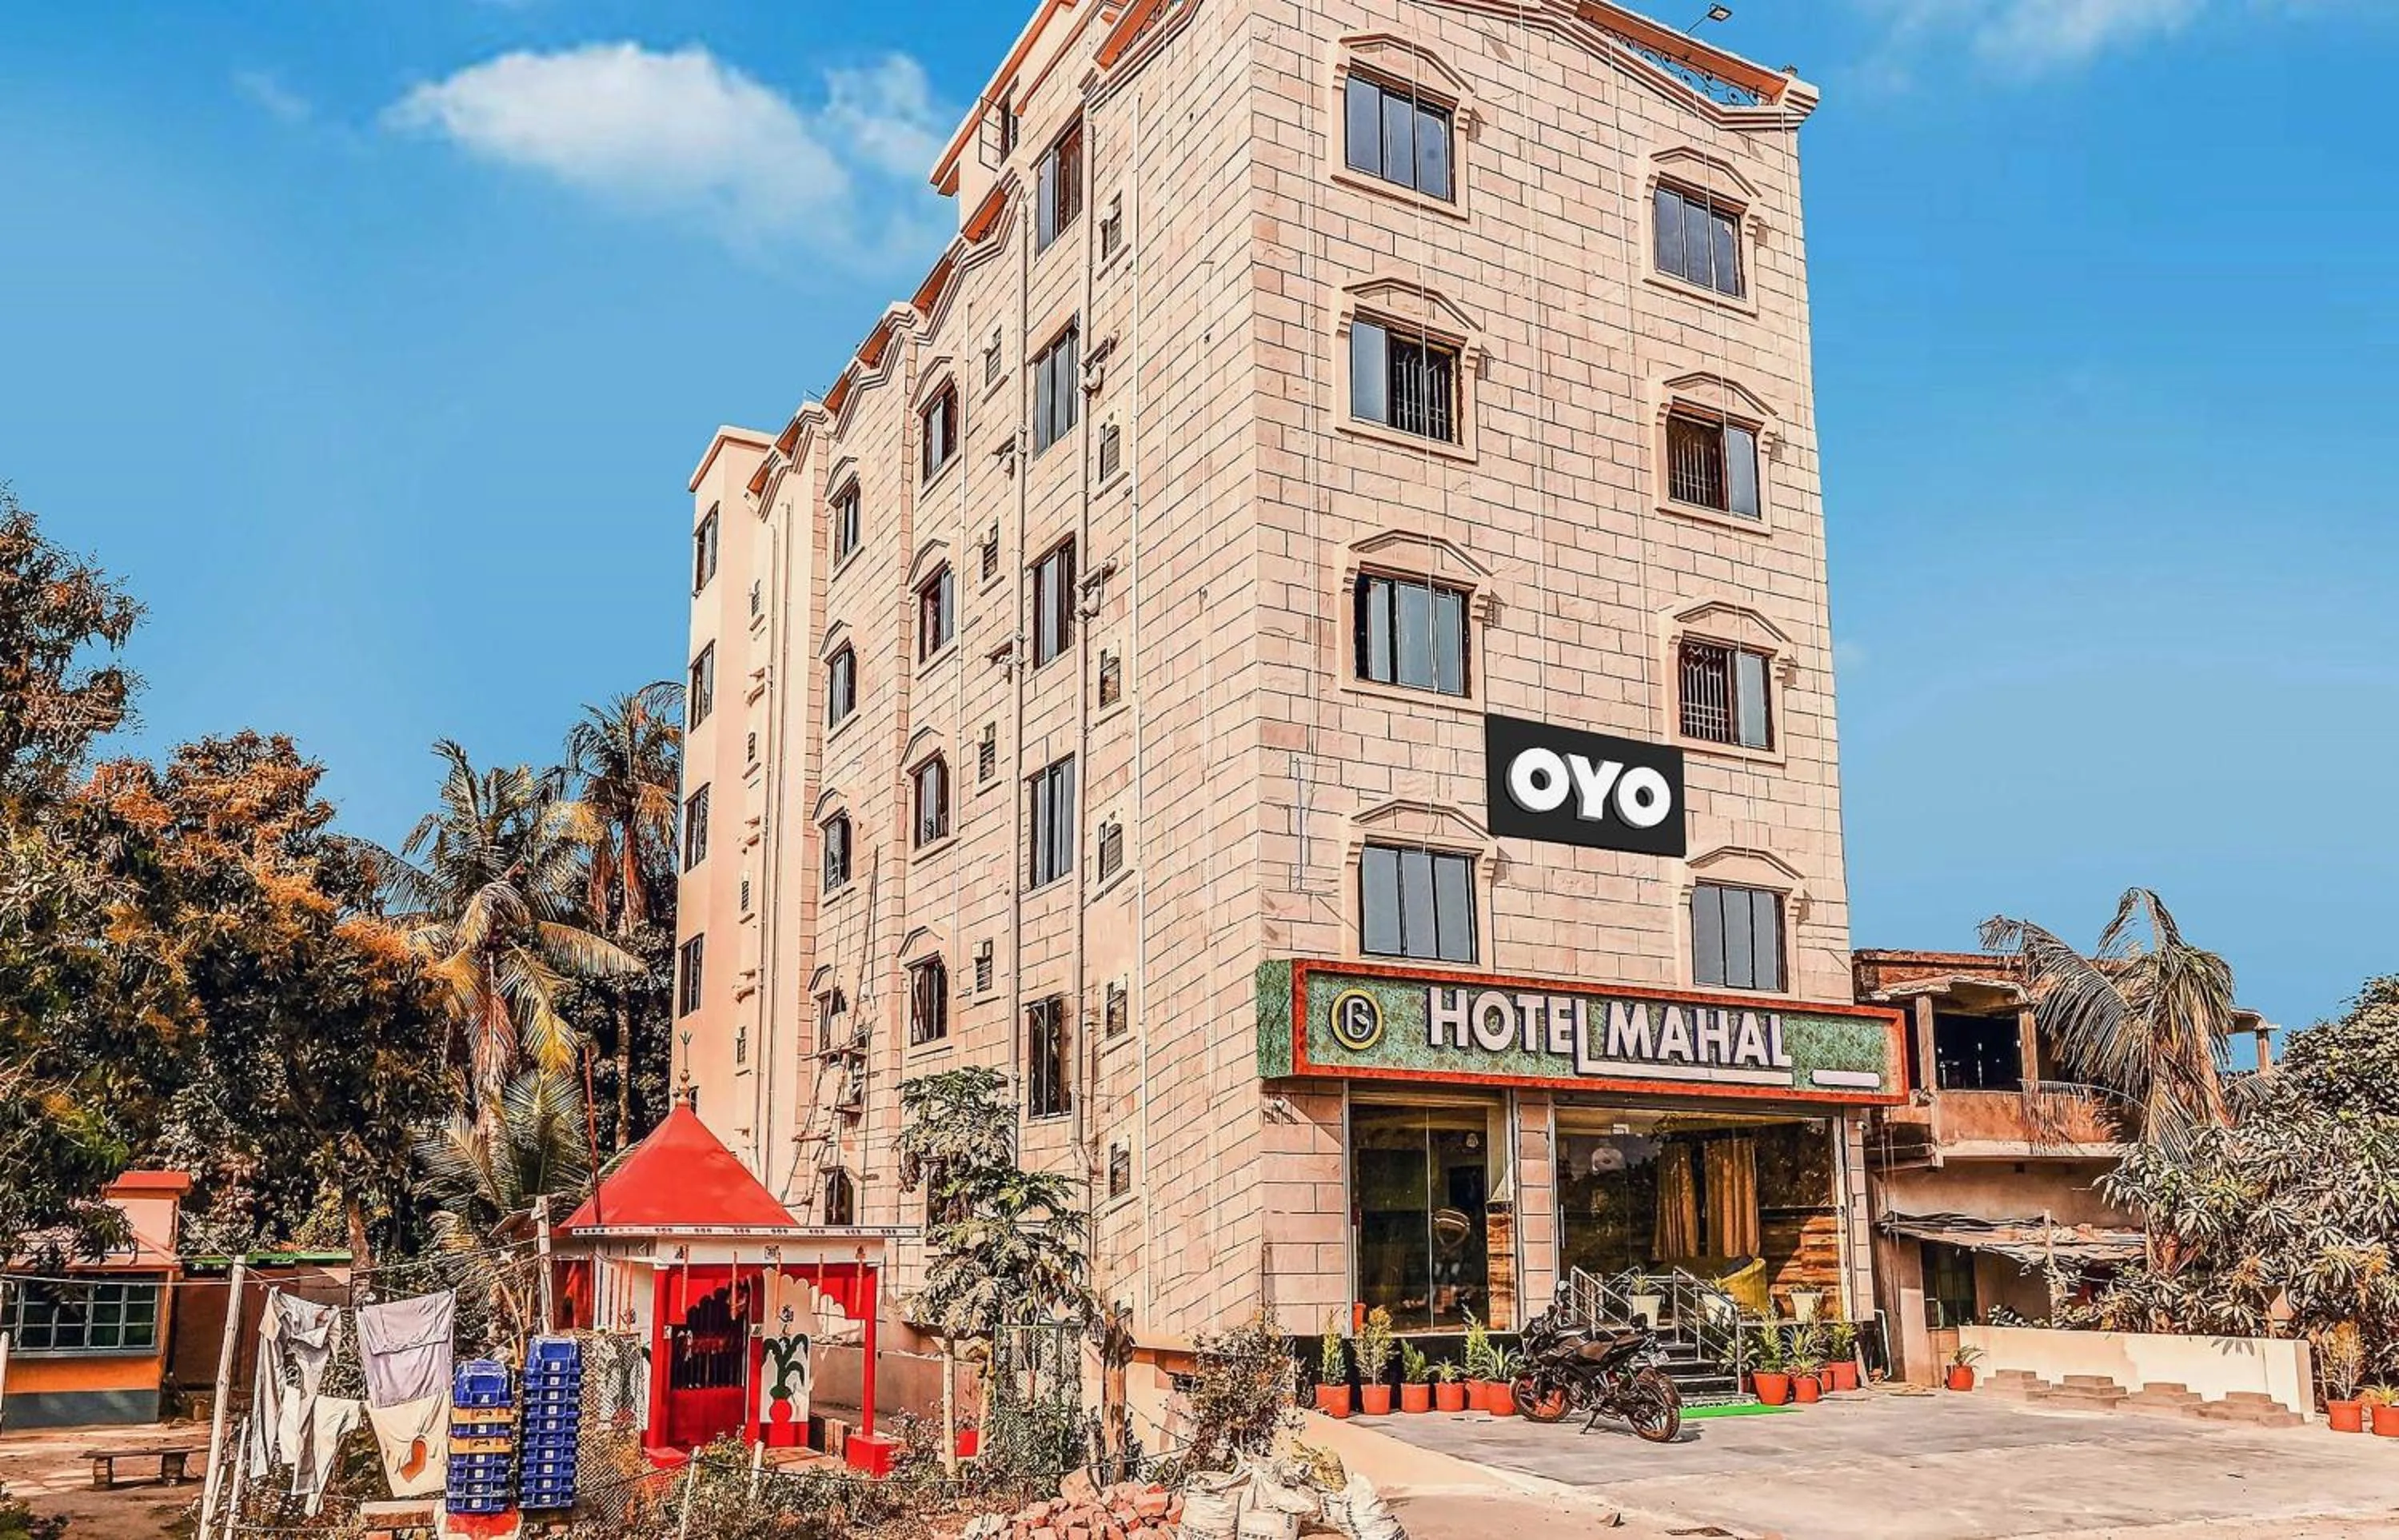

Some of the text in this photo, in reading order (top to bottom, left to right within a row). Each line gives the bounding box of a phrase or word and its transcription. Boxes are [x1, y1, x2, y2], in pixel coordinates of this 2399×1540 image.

[1506, 747, 1672, 829] OYO
[1428, 987, 1792, 1074] HOTEL MAHAL
